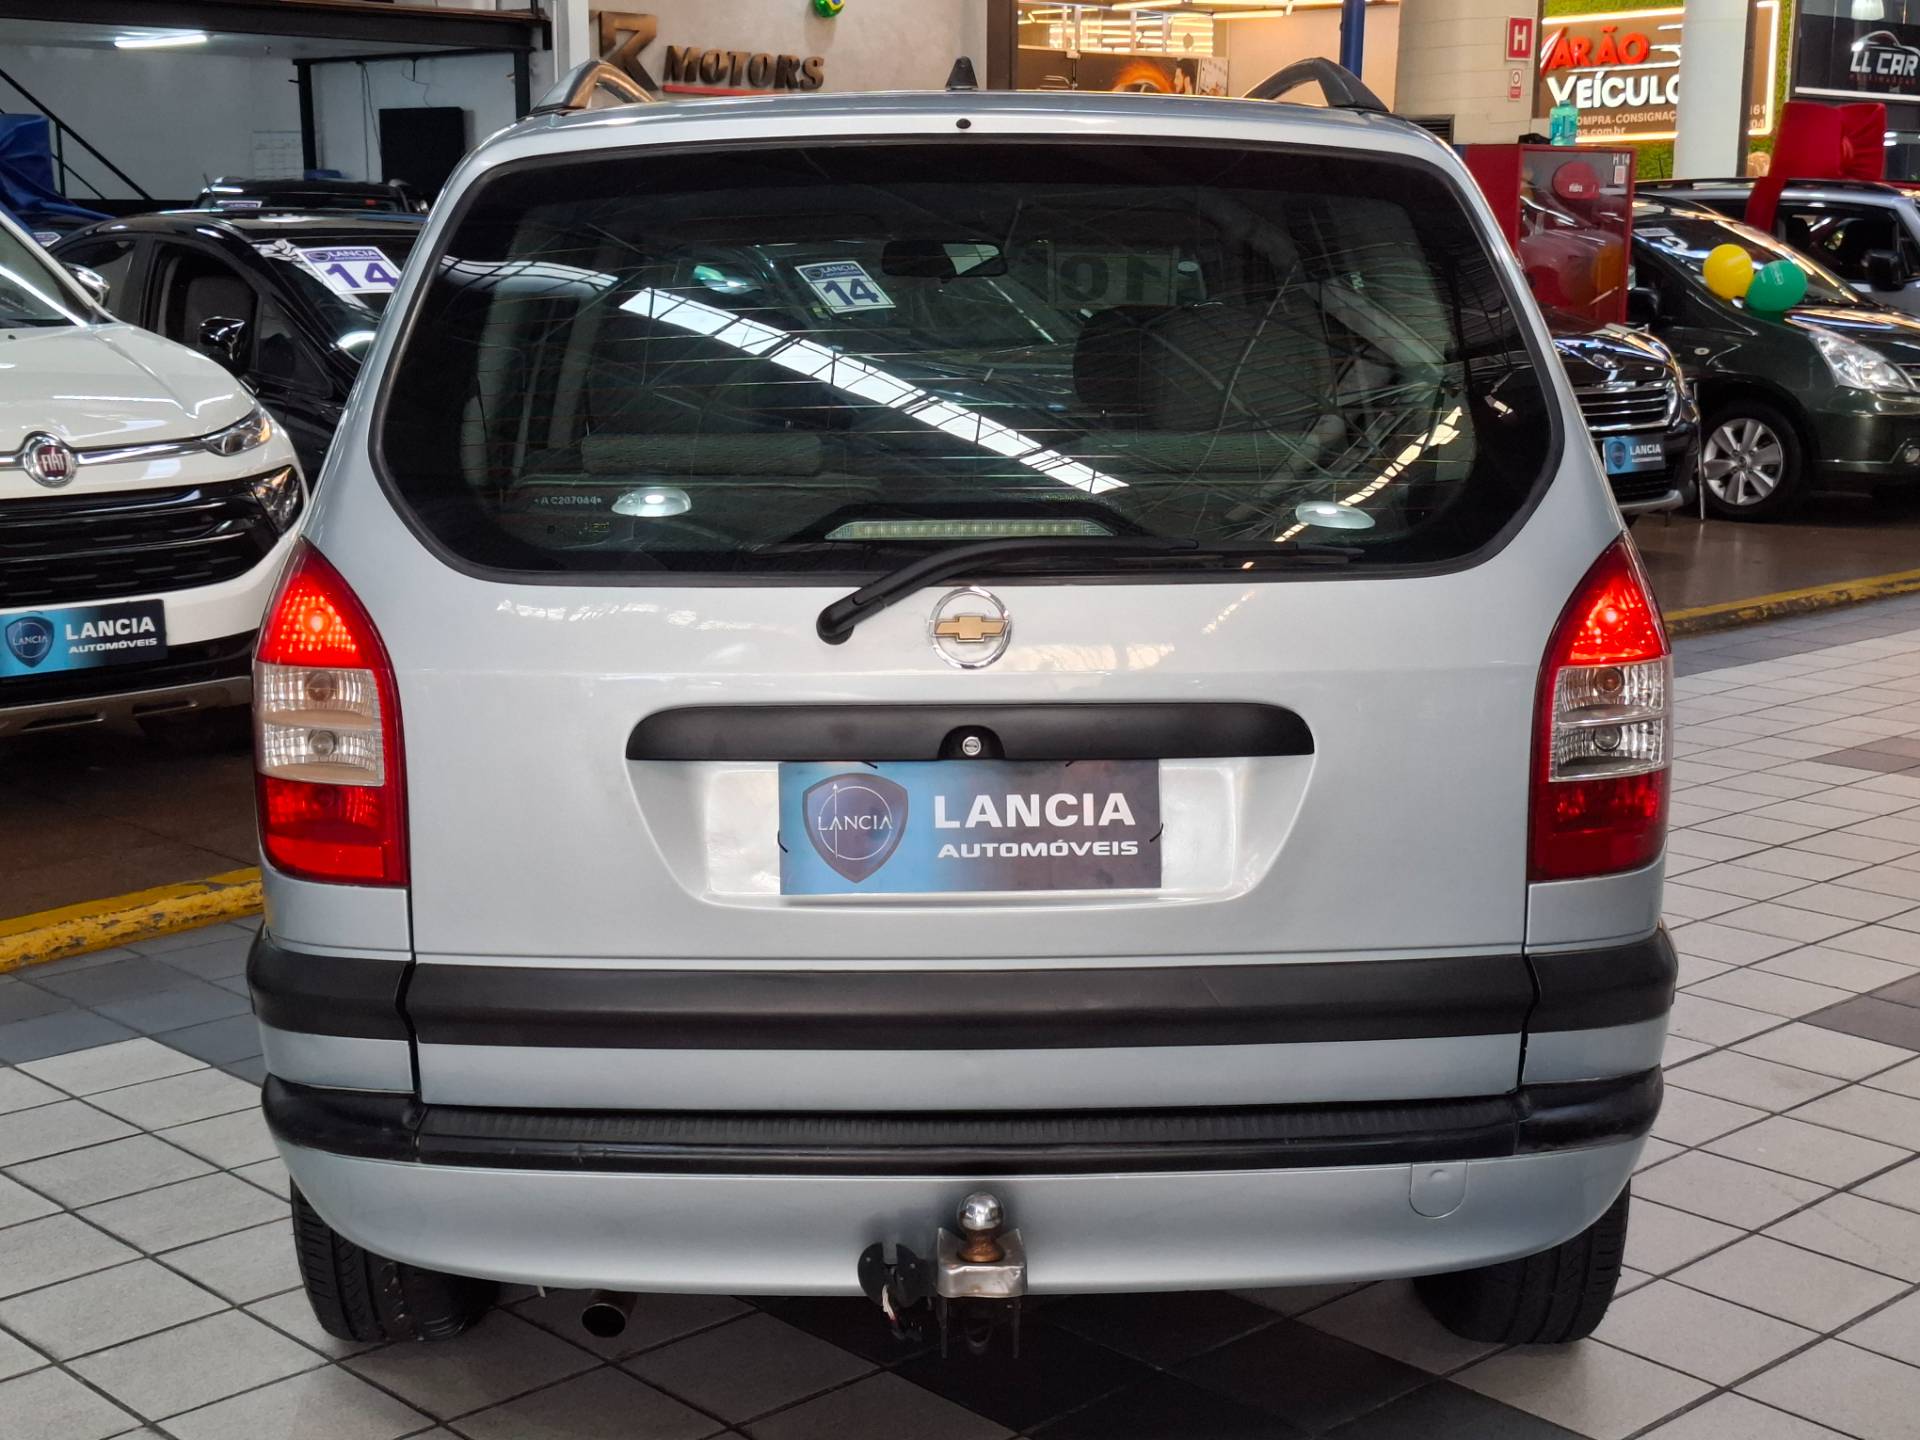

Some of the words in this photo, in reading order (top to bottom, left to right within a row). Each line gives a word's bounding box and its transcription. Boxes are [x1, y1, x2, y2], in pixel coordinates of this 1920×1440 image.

[1513, 25, 1527, 51] H
[663, 45, 825, 90] MOTORS
[1876, 53, 1919, 76] CAR
[329, 250, 378, 258] LANCIA
[325, 263, 399, 288] 14
[820, 264, 859, 274] LANCIA
[823, 278, 880, 306] 14
[1630, 443, 1662, 456] LANCIA
[41, 451, 66, 472] FIAT
[65, 616, 156, 641] LANCIA
[12, 634, 48, 646] LANCIA
[68, 637, 158, 654] AUTOMÓVEIS
[934, 792, 1136, 829] LANCIA
[818, 815, 893, 831] LANCIA
[937, 839, 1139, 859] AUTOMÓVEIS
